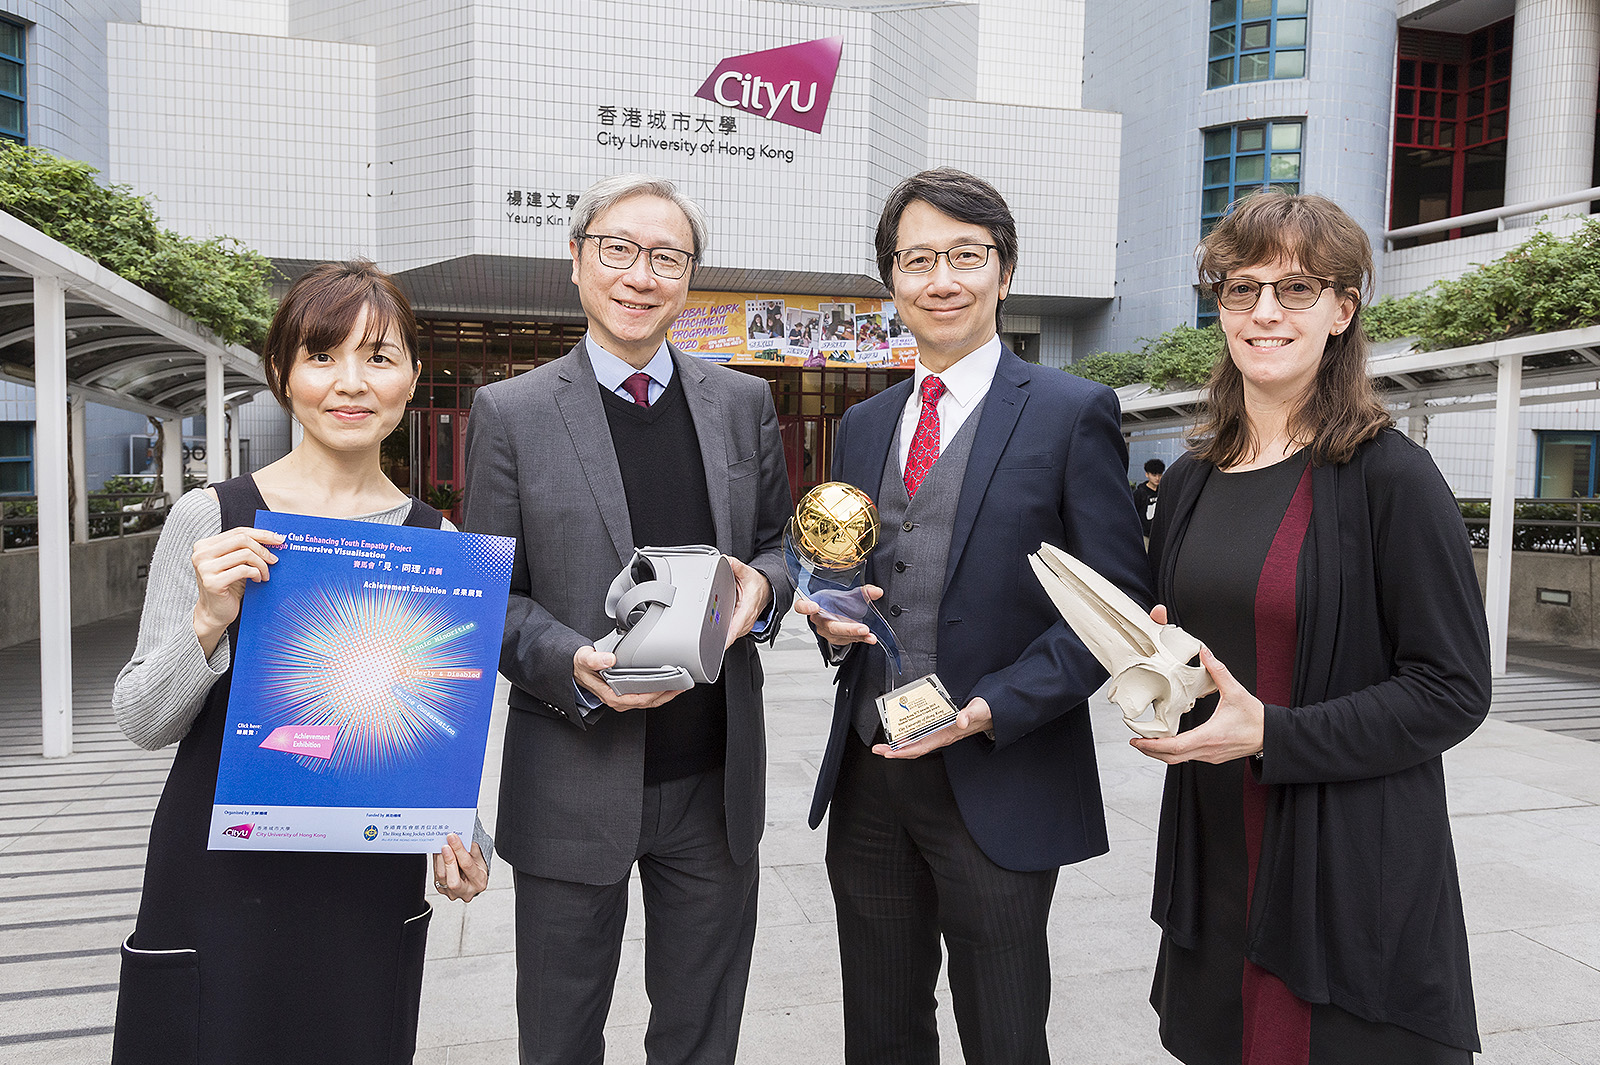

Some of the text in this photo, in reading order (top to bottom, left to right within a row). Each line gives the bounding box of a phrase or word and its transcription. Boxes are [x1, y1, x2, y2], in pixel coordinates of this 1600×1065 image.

[713, 71, 818, 120] CityU
[597, 105, 738, 136] 香港城市大學
[596, 132, 794, 163] City University of Hong Kong
[506, 212, 542, 227] Yeung
[547, 215, 564, 226] Kin
[710, 304, 740, 315] WORK
[670, 315, 728, 331] ATTACHMENT
[672, 326, 729, 341] PROGRAMME
[674, 340, 699, 351] 2020
[288, 532, 304, 542] Club
[305, 534, 340, 547] Enhancing
[340, 538, 360, 547] Youth
[361, 540, 389, 551] Empathy
[389, 543, 412, 553] Project
[290, 543, 333, 554] Immersive
[334, 547, 386, 559] Visualisation
[363, 581, 410, 592] Achievement
[411, 585, 447, 595] Exhibition
[416, 704, 456, 736] Conservation
[293, 732, 331, 740] Achievement
[225, 829, 249, 838] CityU
